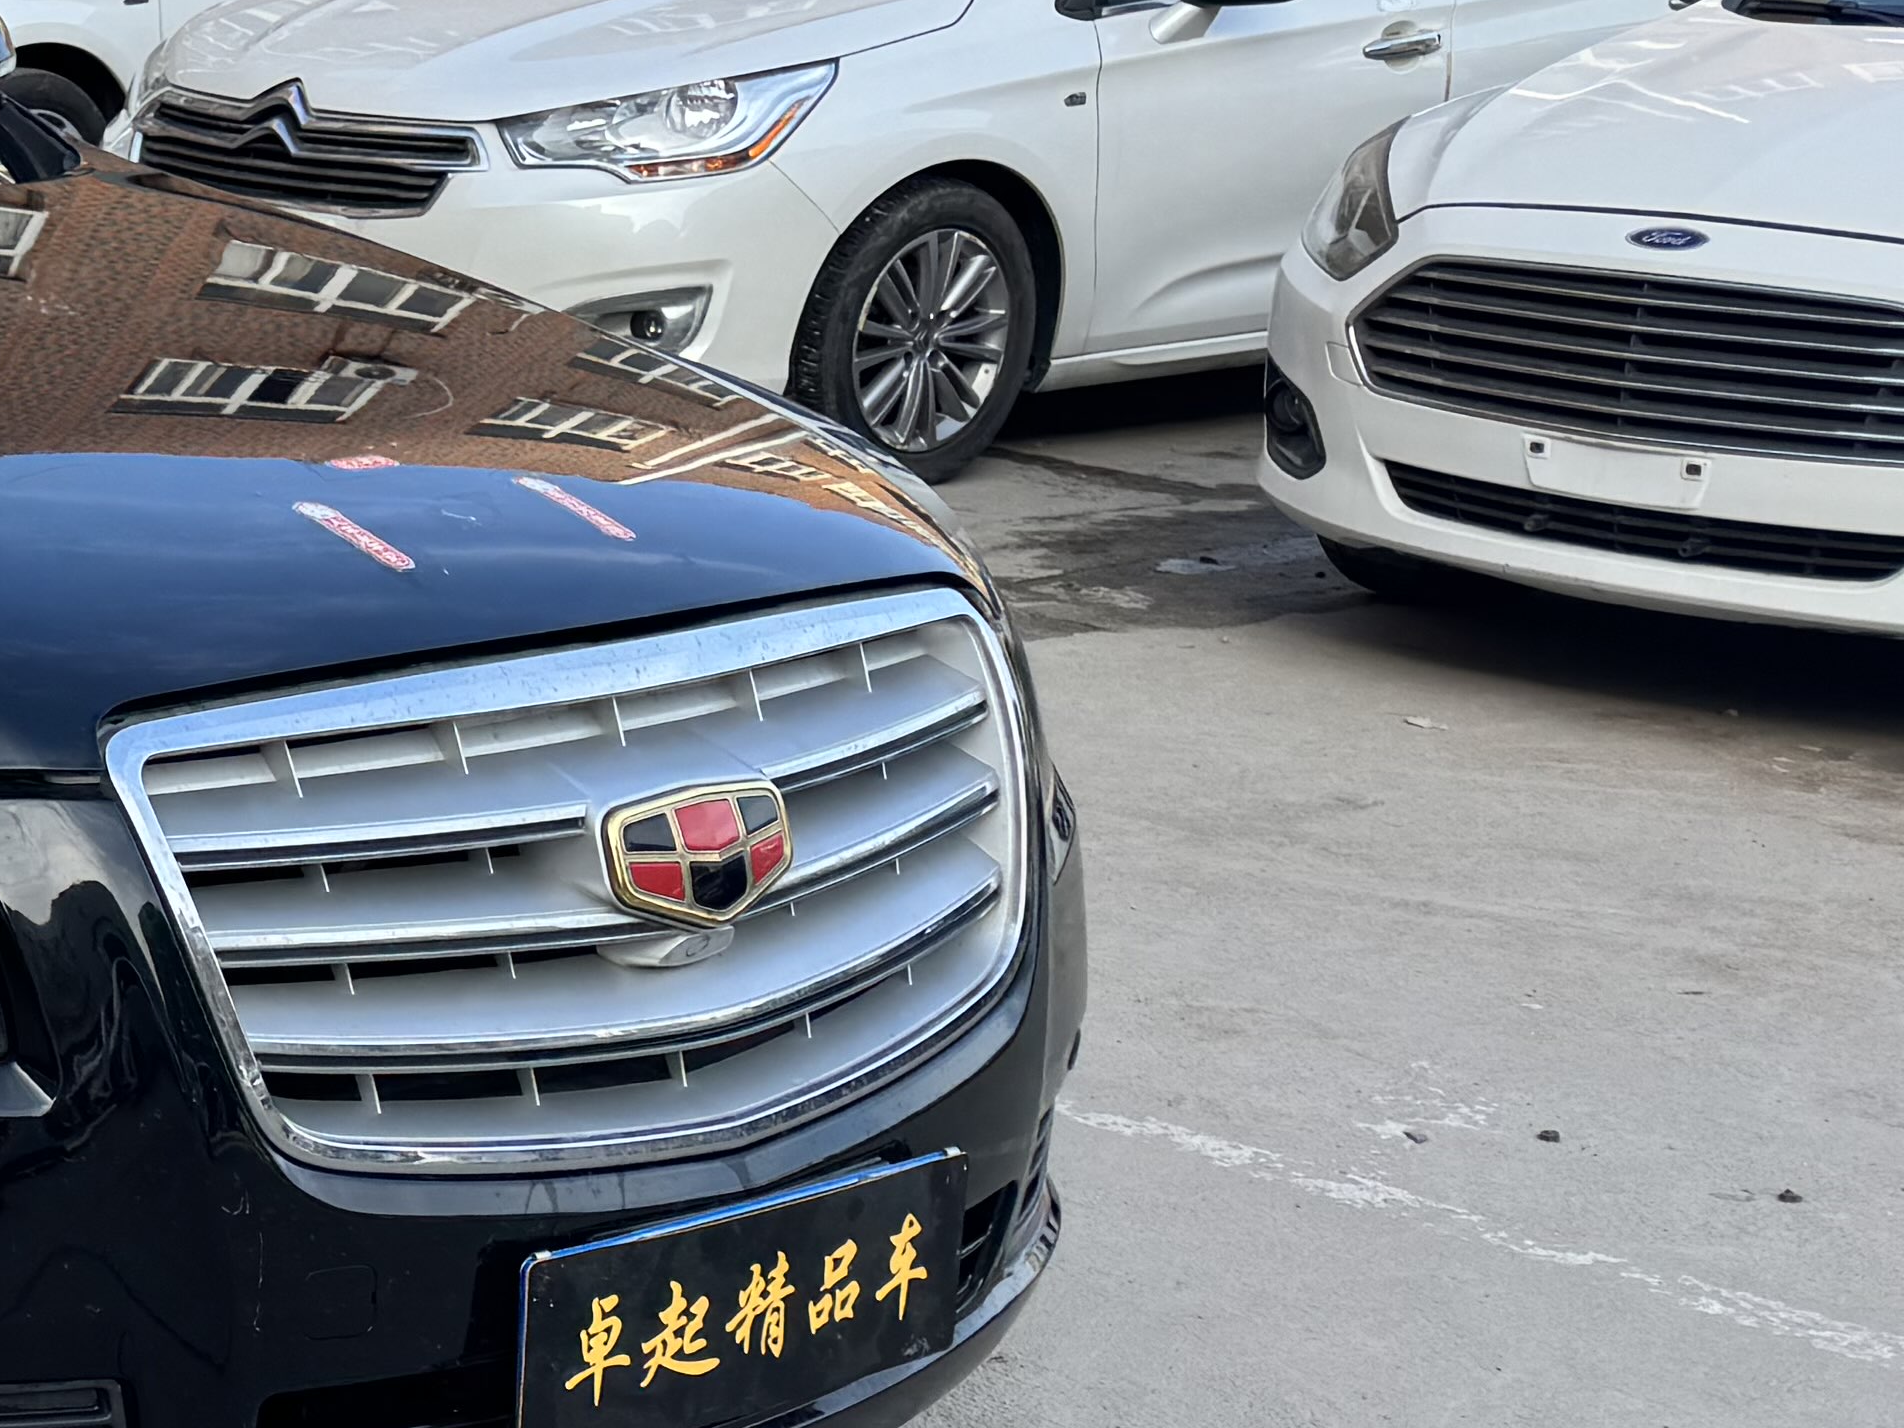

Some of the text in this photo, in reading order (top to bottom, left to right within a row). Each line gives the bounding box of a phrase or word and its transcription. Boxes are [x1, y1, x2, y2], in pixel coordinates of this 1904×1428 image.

[1641, 231, 1692, 246] Ford
[564, 1212, 928, 1407] 卓起精品车
